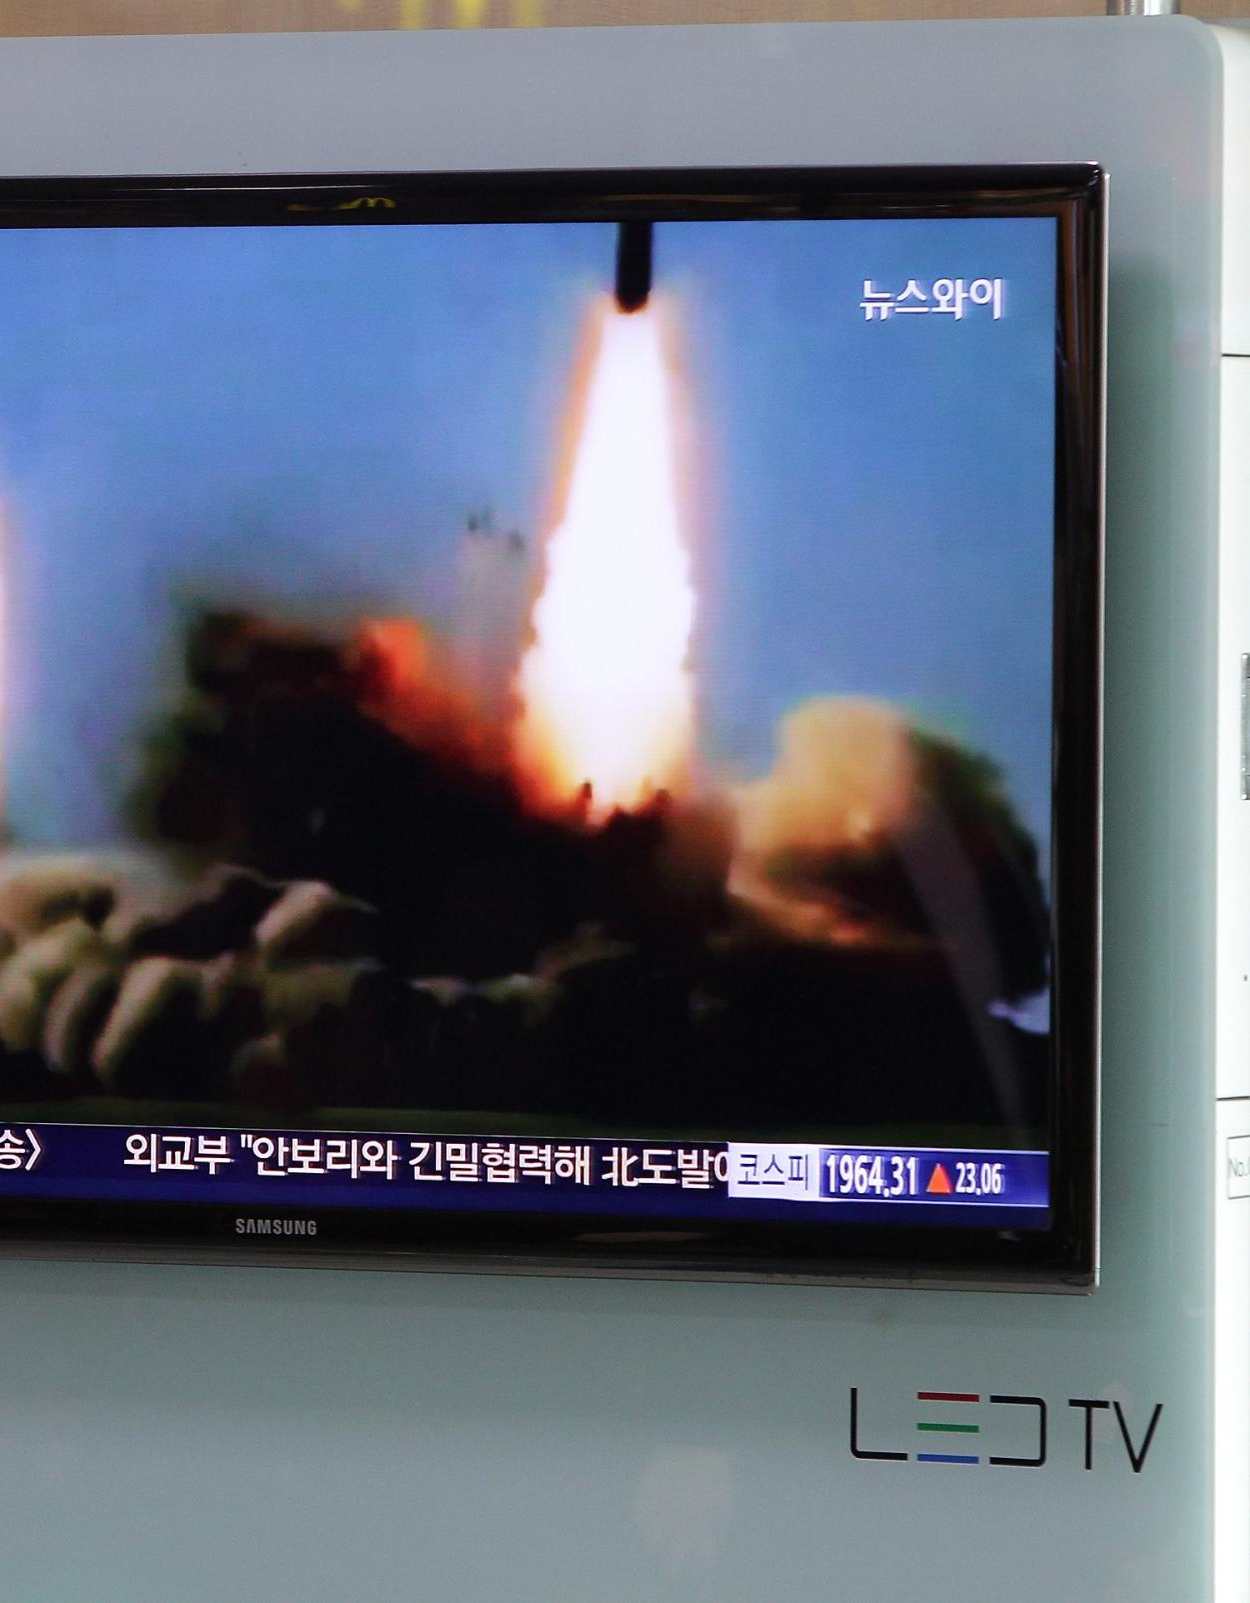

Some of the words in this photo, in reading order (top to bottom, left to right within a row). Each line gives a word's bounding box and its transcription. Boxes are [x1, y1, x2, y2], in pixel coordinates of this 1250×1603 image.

[859, 278, 1005, 320] 뉴스와이
[123, 1133, 235, 1175] 외교부
[240, 1134, 402, 1180] "안보리와
[408, 1141, 591, 1185] 긴밀협력해
[737, 1153, 809, 1191] 코스피
[826, 1154, 919, 1197] 1964.31
[955, 1162, 1005, 1195] 23.06
[235, 1218, 317, 1236] SAMSUNG
[851, 1387, 1047, 1467] LED
[1068, 1398, 1163, 1474] TV
